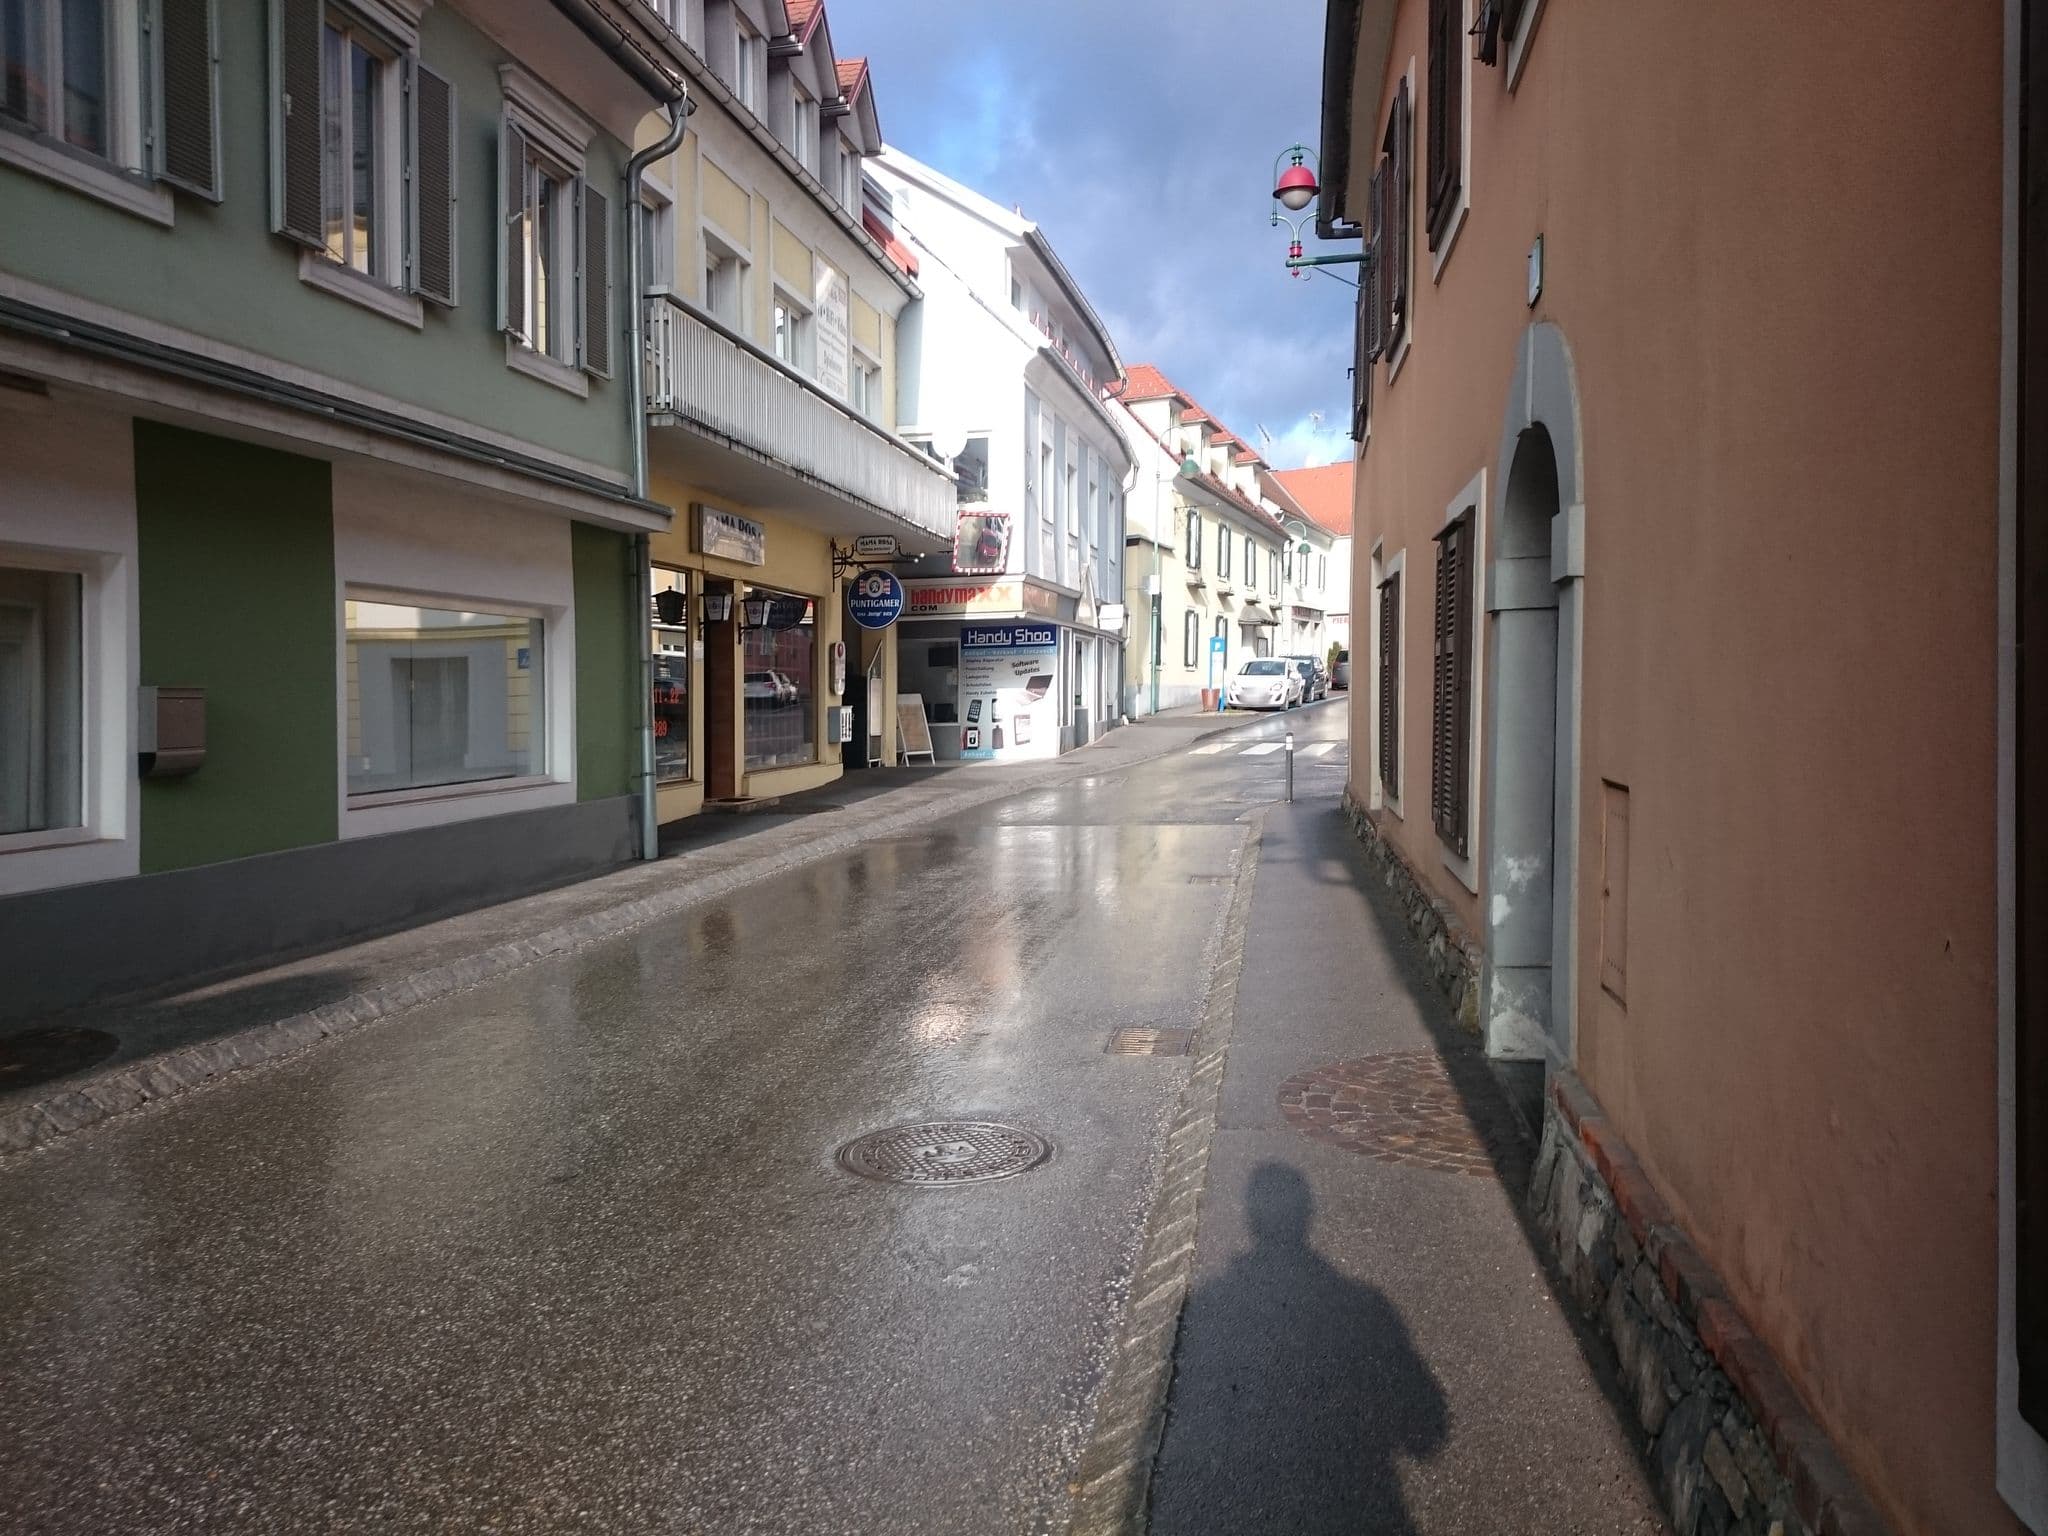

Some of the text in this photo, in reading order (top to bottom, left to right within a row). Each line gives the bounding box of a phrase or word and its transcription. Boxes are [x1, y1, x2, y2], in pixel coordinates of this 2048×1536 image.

[850, 599, 900, 608] PUNTIGAMER
[967, 628, 1052, 645] Handy Shop
[1011, 659, 1040, 668] Software
[1015, 667, 1040, 676] Updates
